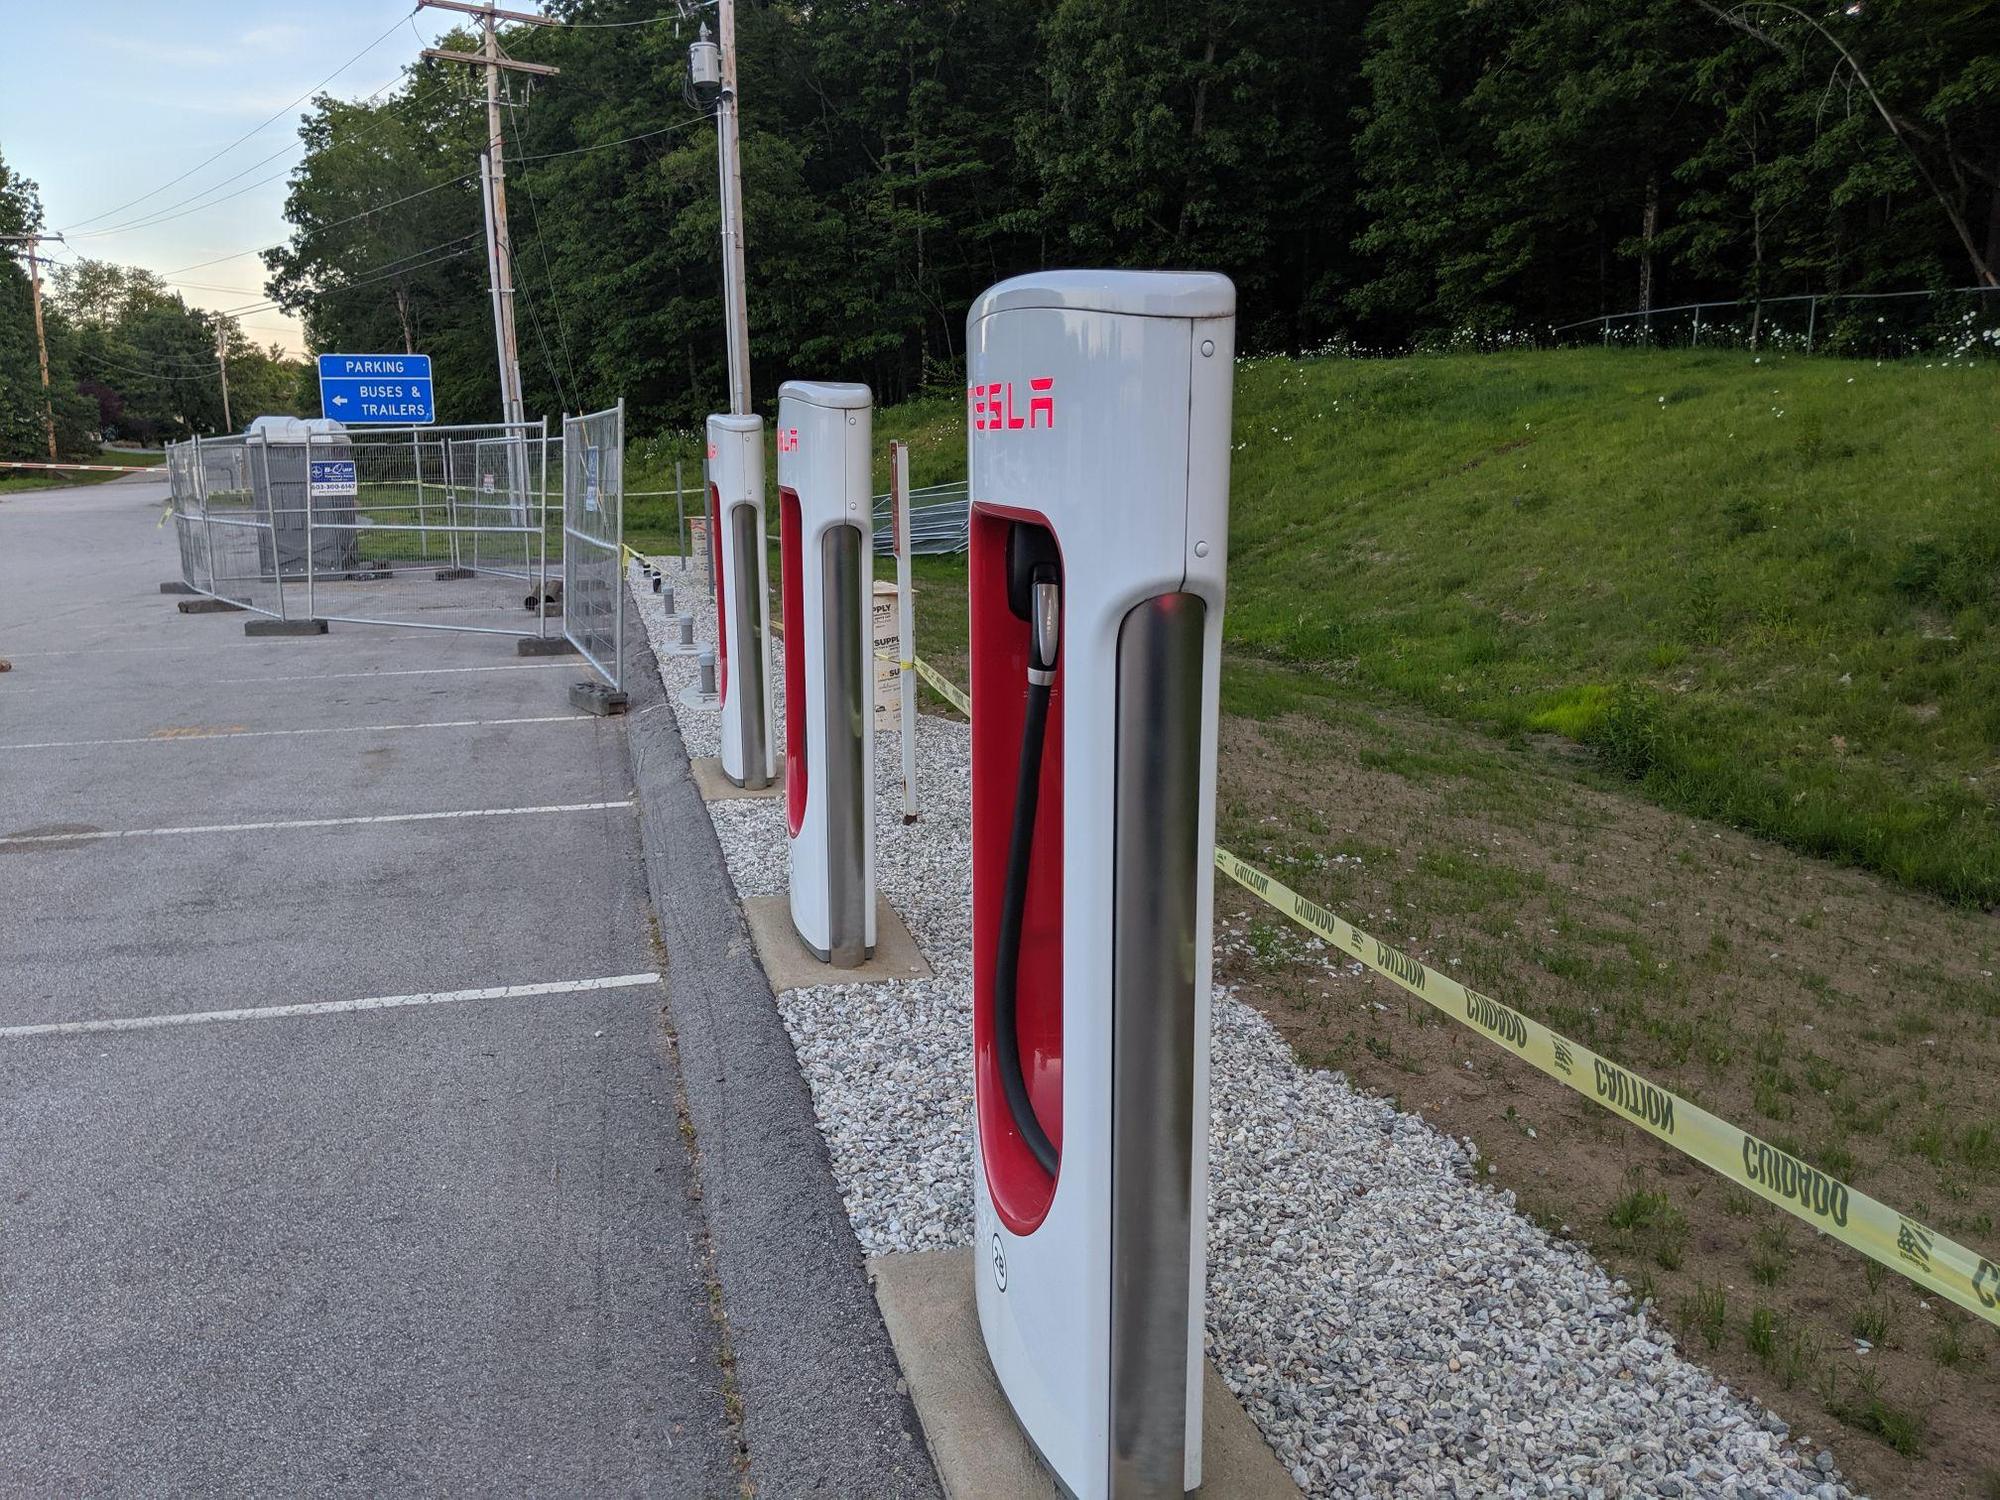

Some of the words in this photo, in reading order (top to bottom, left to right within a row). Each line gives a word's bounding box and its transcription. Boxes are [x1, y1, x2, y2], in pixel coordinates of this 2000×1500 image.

[345, 361, 405, 373] PARKING
[359, 386, 403, 398] BUSES
[411, 386, 421, 398] &
[361, 404, 426, 416] TRAILERS
[967, 377, 1054, 433] ESLA
[874, 636, 900, 647] SUPPL
